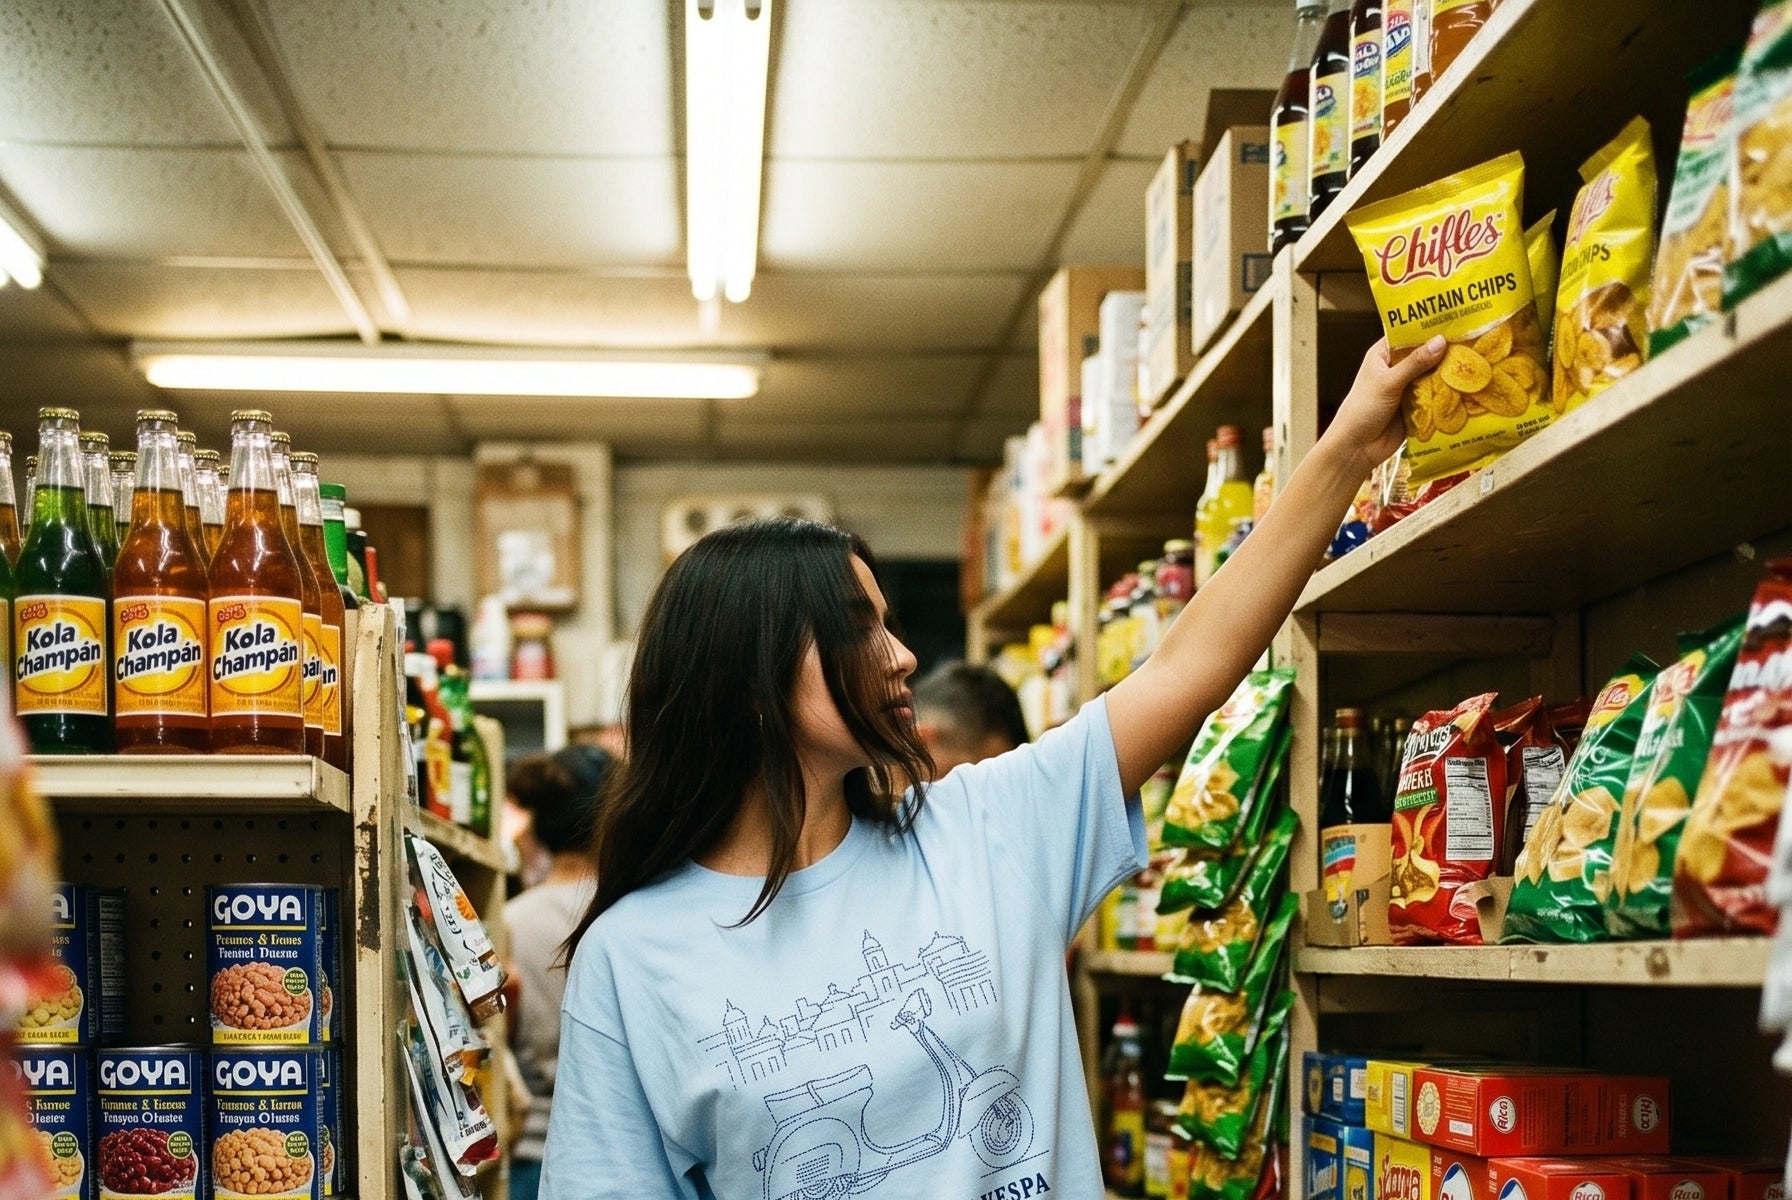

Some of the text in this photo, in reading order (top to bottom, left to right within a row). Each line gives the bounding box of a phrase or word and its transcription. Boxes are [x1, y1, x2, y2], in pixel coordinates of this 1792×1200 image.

[1374, 208, 1500, 286] Chifles
[1387, 287, 1465, 328] PLANTAIN
[1467, 272, 1517, 301] CHIPS
[27, 622, 76, 653] Kola
[128, 623, 178, 653] Kola
[225, 623, 276, 653] Kola
[17, 640, 101, 681] Champán
[116, 641, 201, 681] Champán
[213, 641, 298, 681] Champán
[214, 894, 301, 925] GOYA
[100, 1059, 186, 1089] GOYA
[215, 1059, 302, 1090] GOYA
